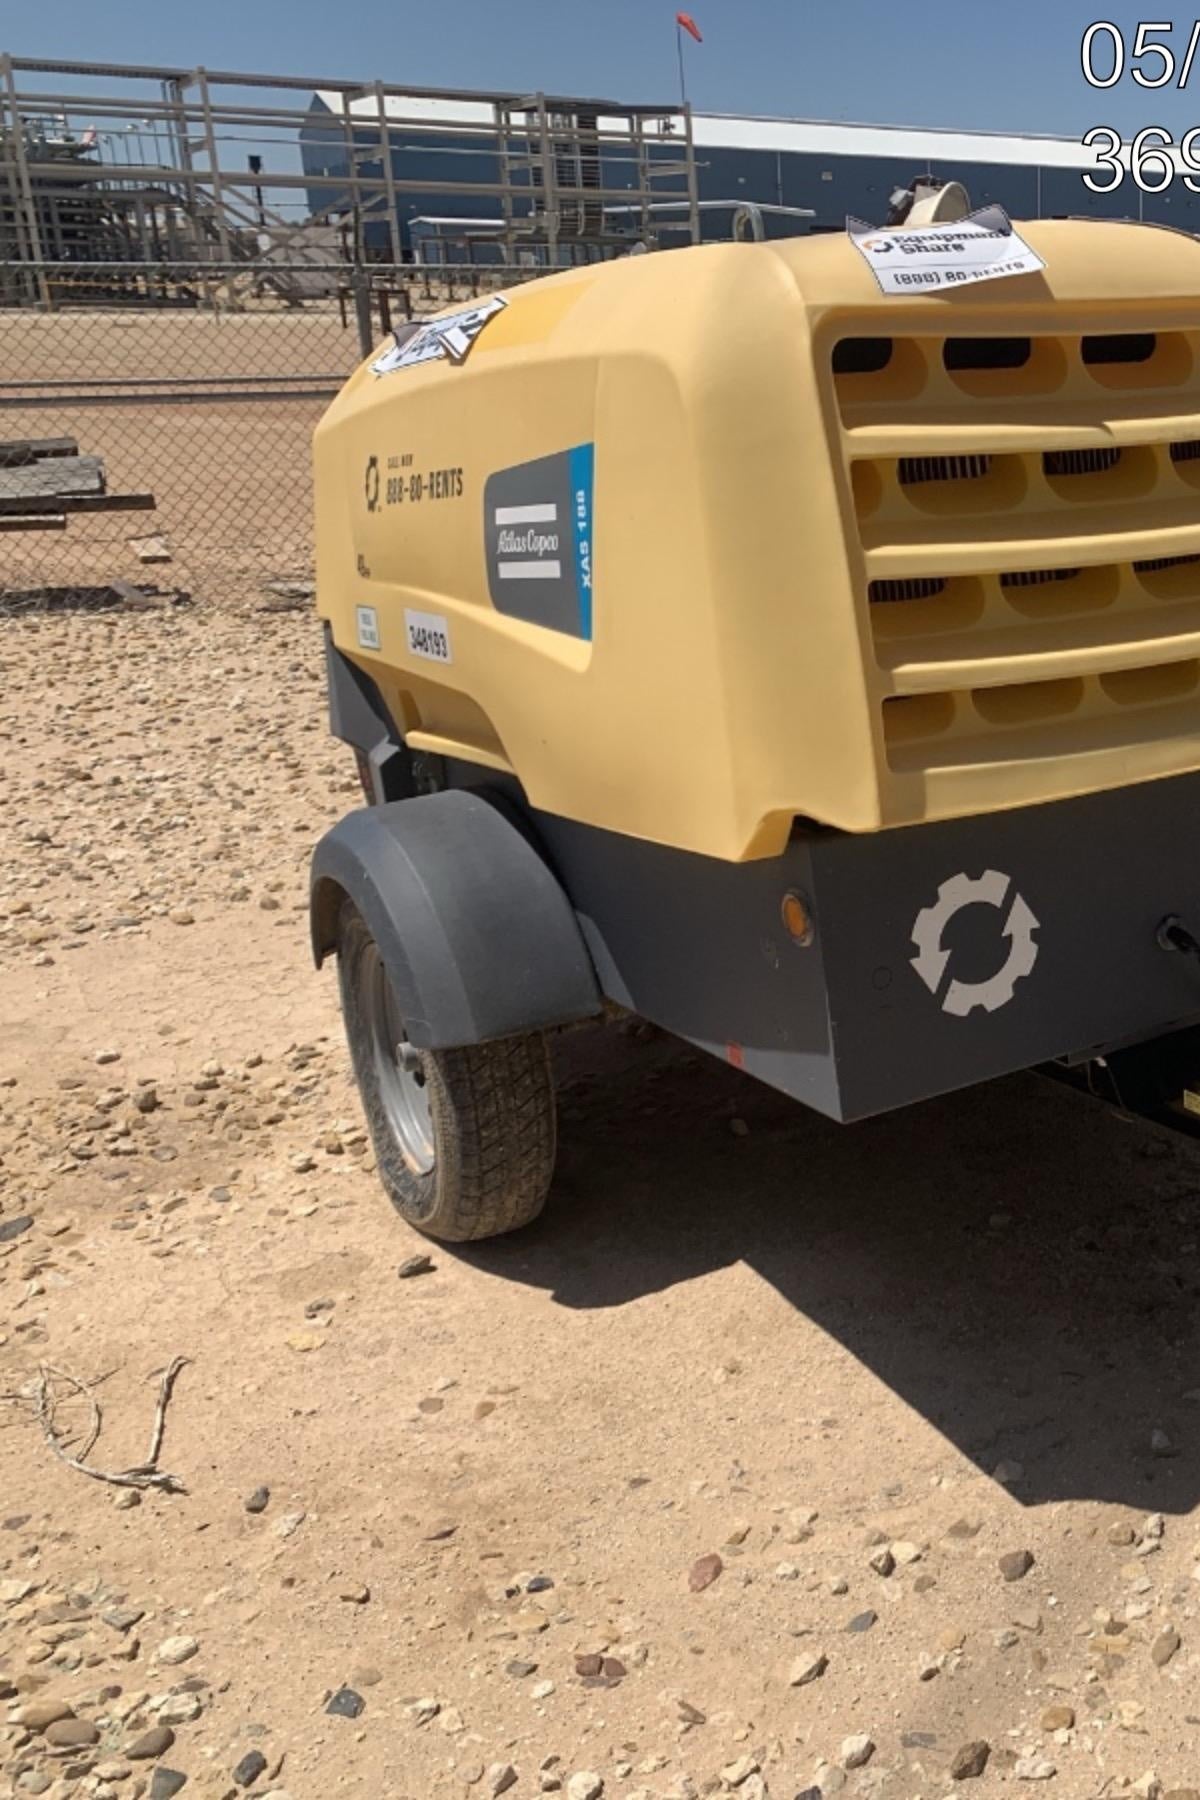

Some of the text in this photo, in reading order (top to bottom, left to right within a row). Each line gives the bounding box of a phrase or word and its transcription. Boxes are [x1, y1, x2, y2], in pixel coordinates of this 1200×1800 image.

[900, 242, 966, 255] Share
[496, 528, 560, 558] Atlas Copco
[408, 624, 448, 659] 348193
